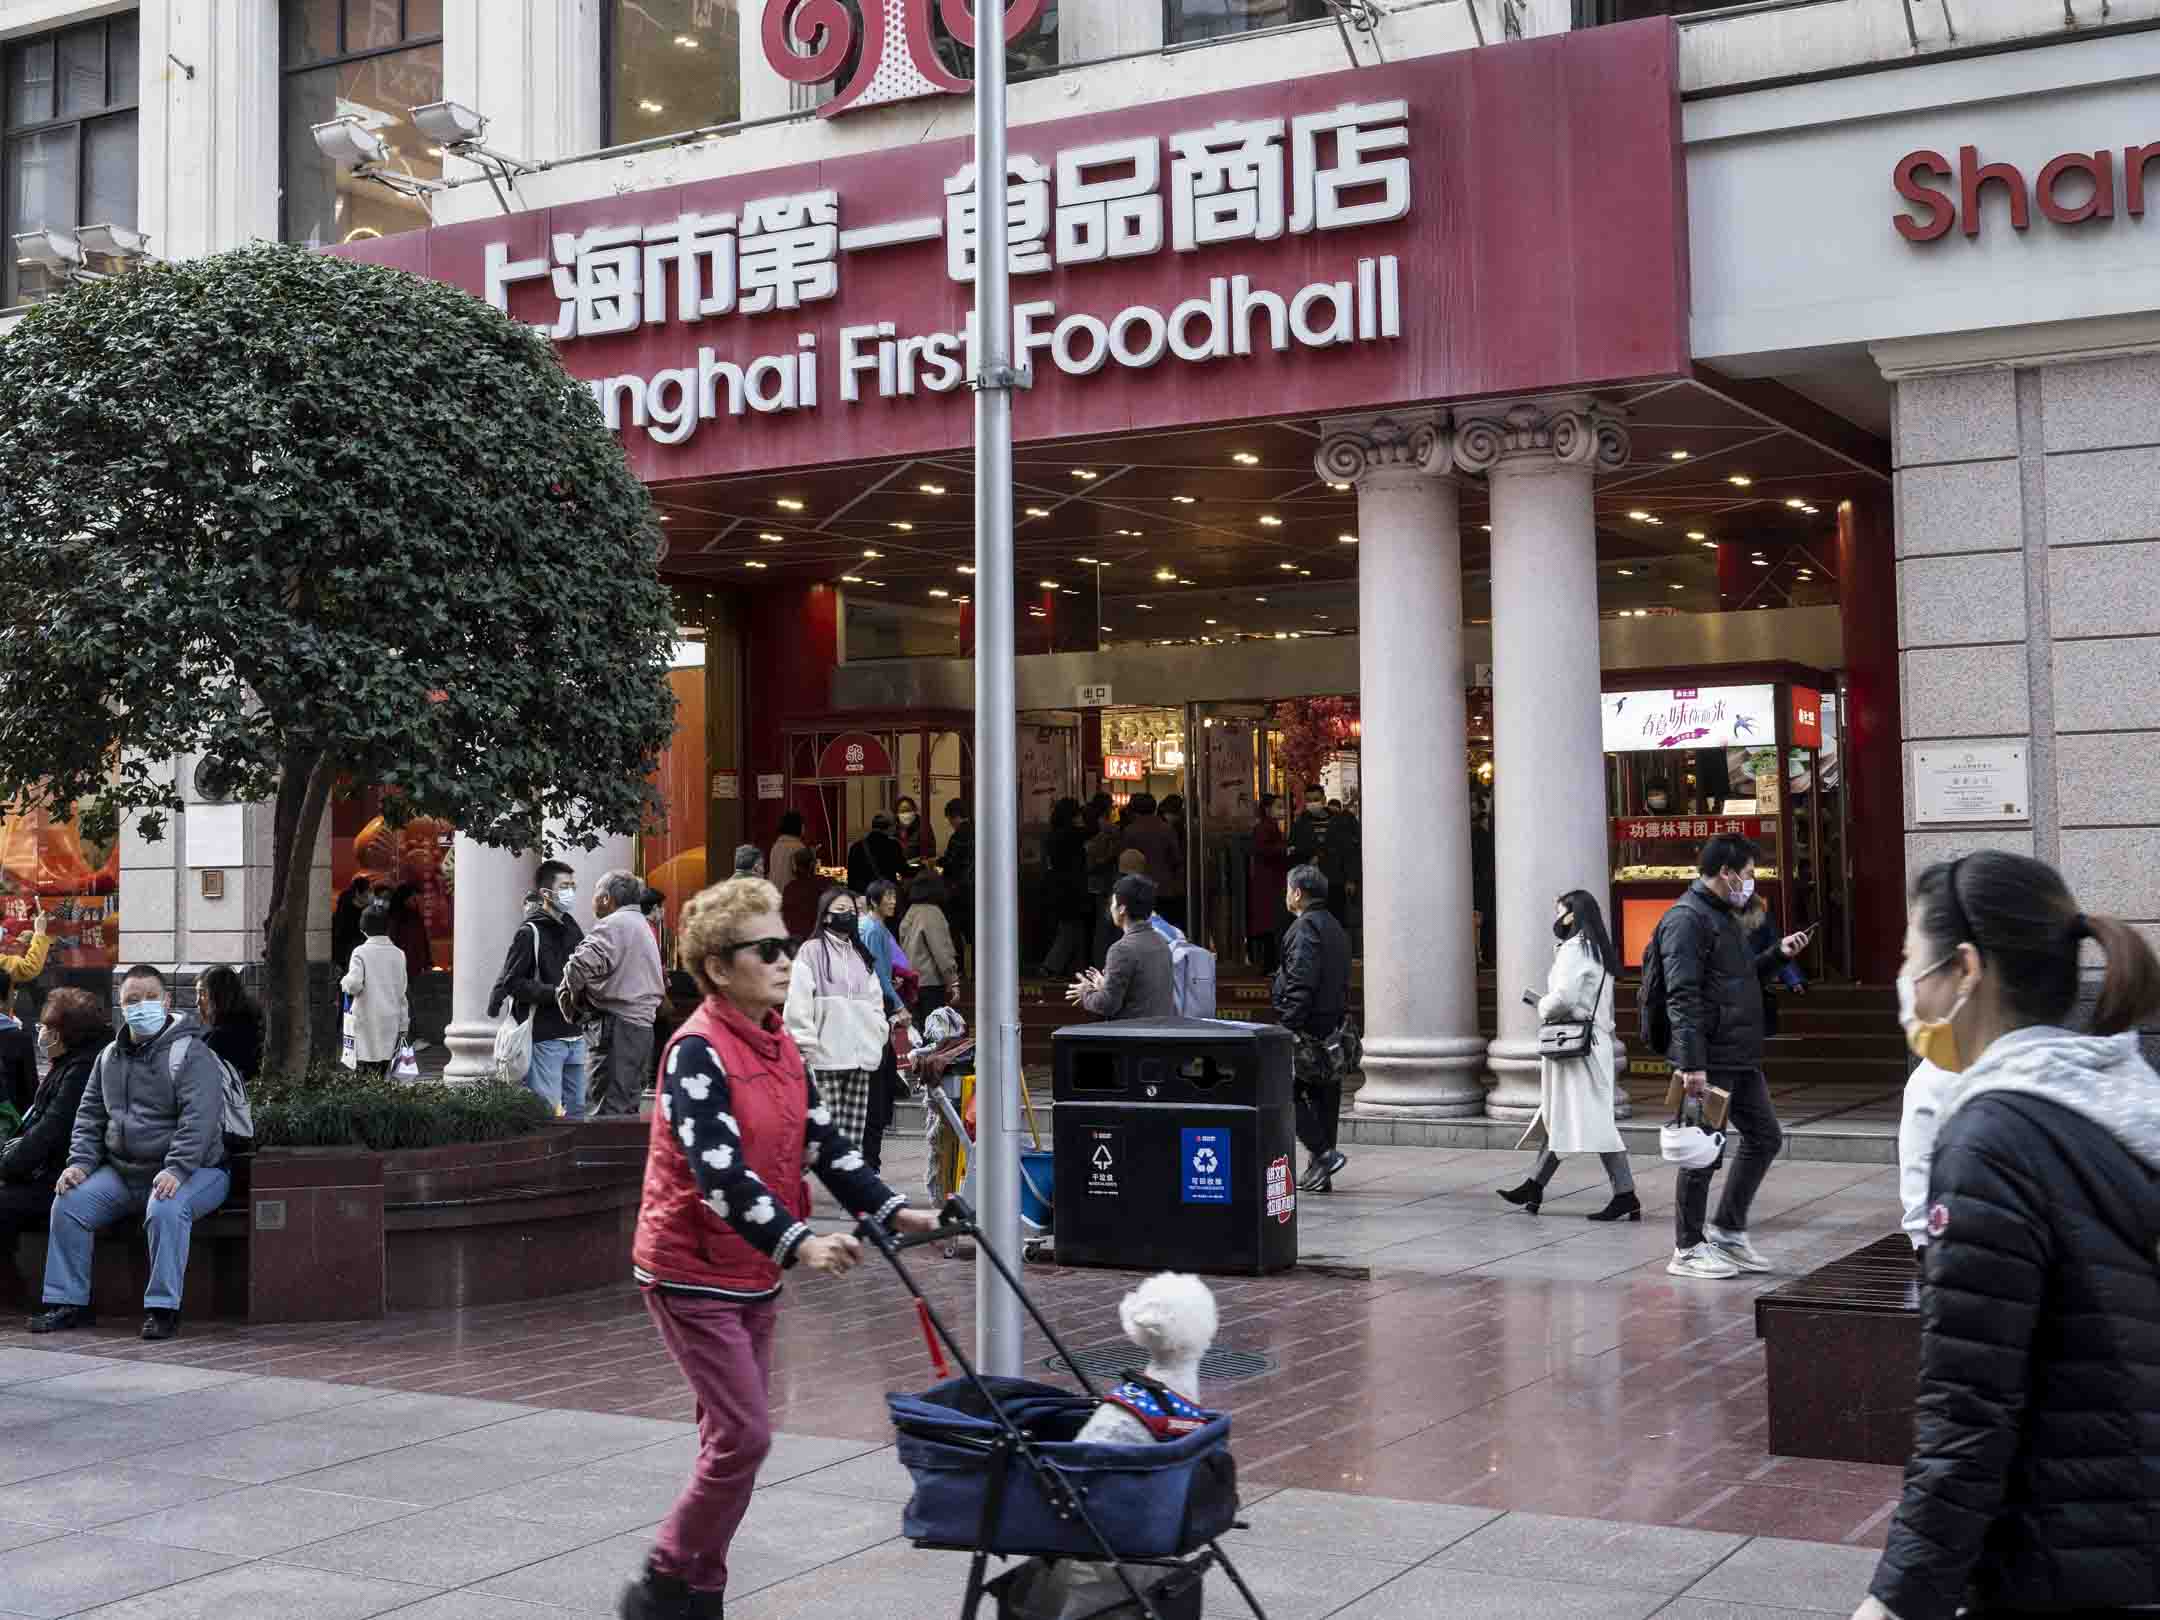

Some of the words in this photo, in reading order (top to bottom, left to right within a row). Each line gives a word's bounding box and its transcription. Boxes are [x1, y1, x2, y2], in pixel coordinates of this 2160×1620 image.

[485, 100, 1410, 340] 上海市第一食品商店
[592, 336, 817, 445] nghai
[1014, 255, 1400, 389] Foodhall
[1083, 687, 1105, 698] 出口
